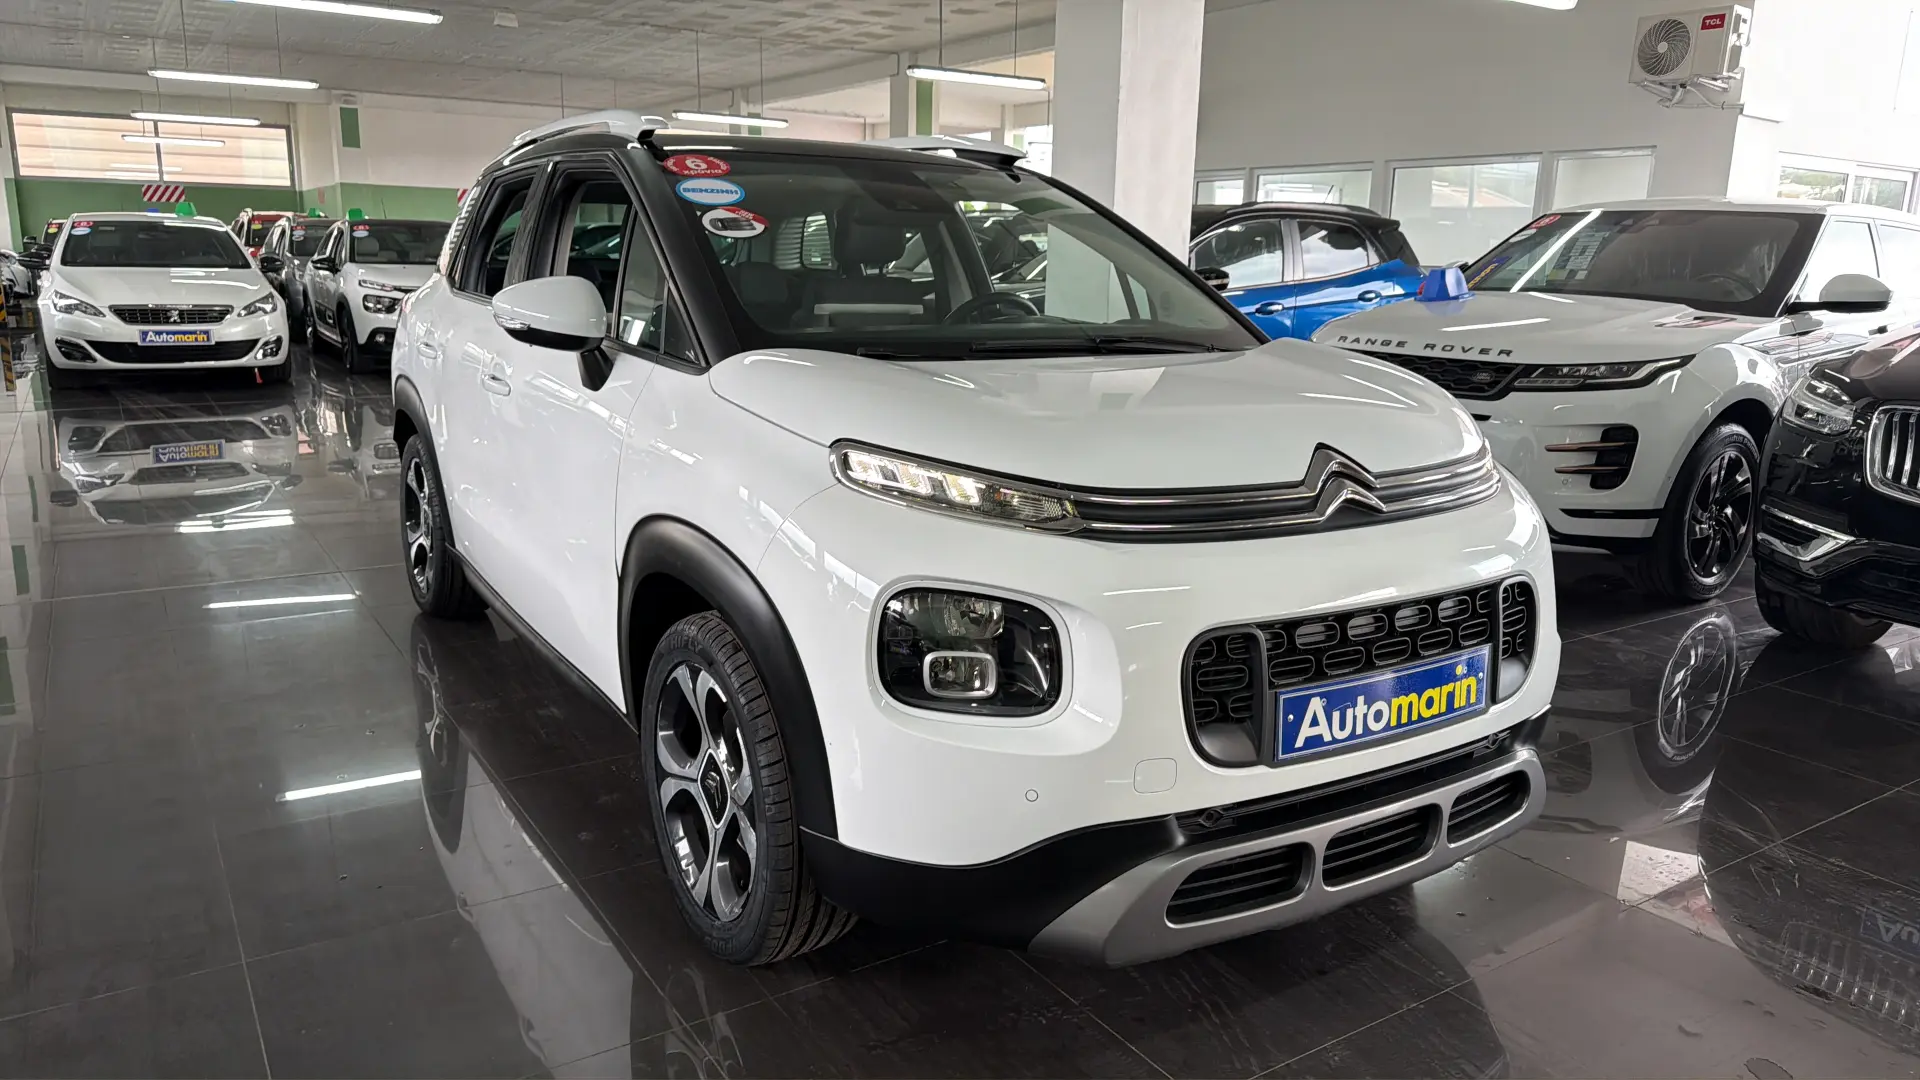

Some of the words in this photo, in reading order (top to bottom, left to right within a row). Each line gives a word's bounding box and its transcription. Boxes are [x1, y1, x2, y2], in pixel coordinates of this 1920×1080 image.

[1705, 18, 1722, 26] TCL
[685, 158, 708, 170] 6
[146, 330, 208, 342] Automarin
[1337, 335, 1409, 348] RANGE
[1423, 343, 1514, 357] ROVER
[1294, 664, 1478, 749] Automarin
